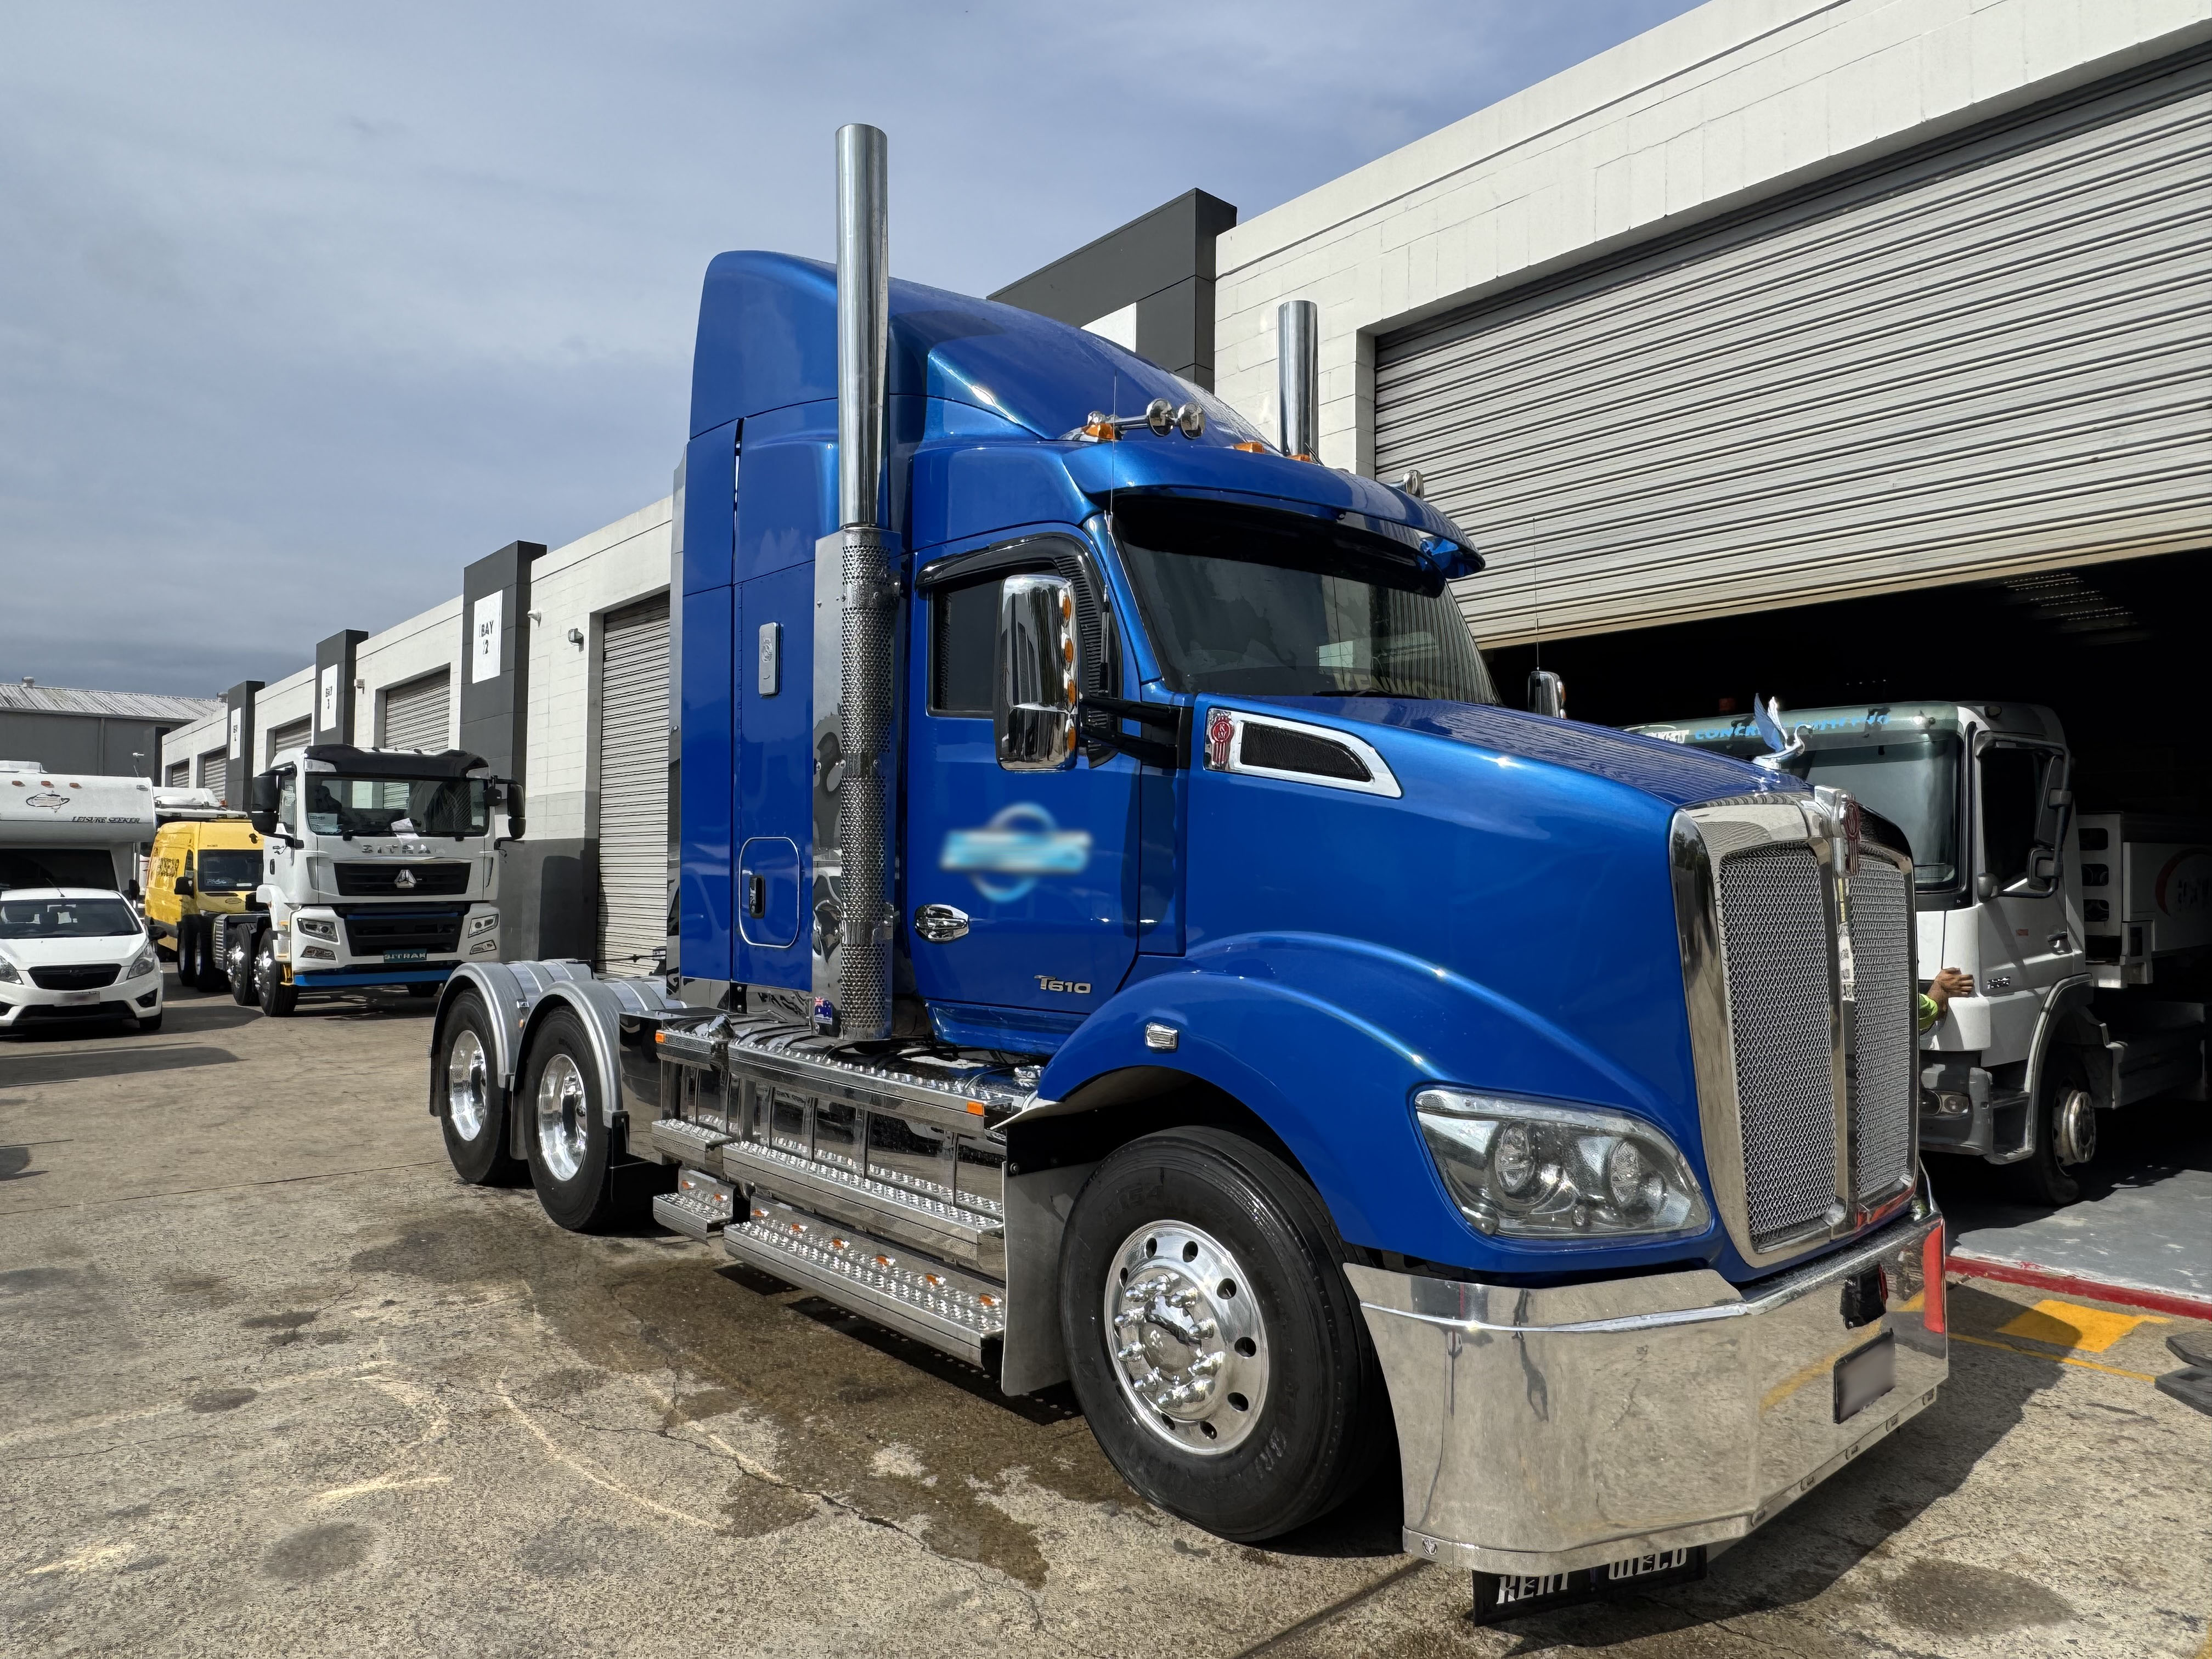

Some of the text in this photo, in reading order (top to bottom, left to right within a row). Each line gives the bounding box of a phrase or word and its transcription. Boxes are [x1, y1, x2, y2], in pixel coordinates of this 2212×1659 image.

[479, 620, 494, 637] BAY
[483, 639, 489, 654] 2
[1034, 975, 1091, 993] T610
